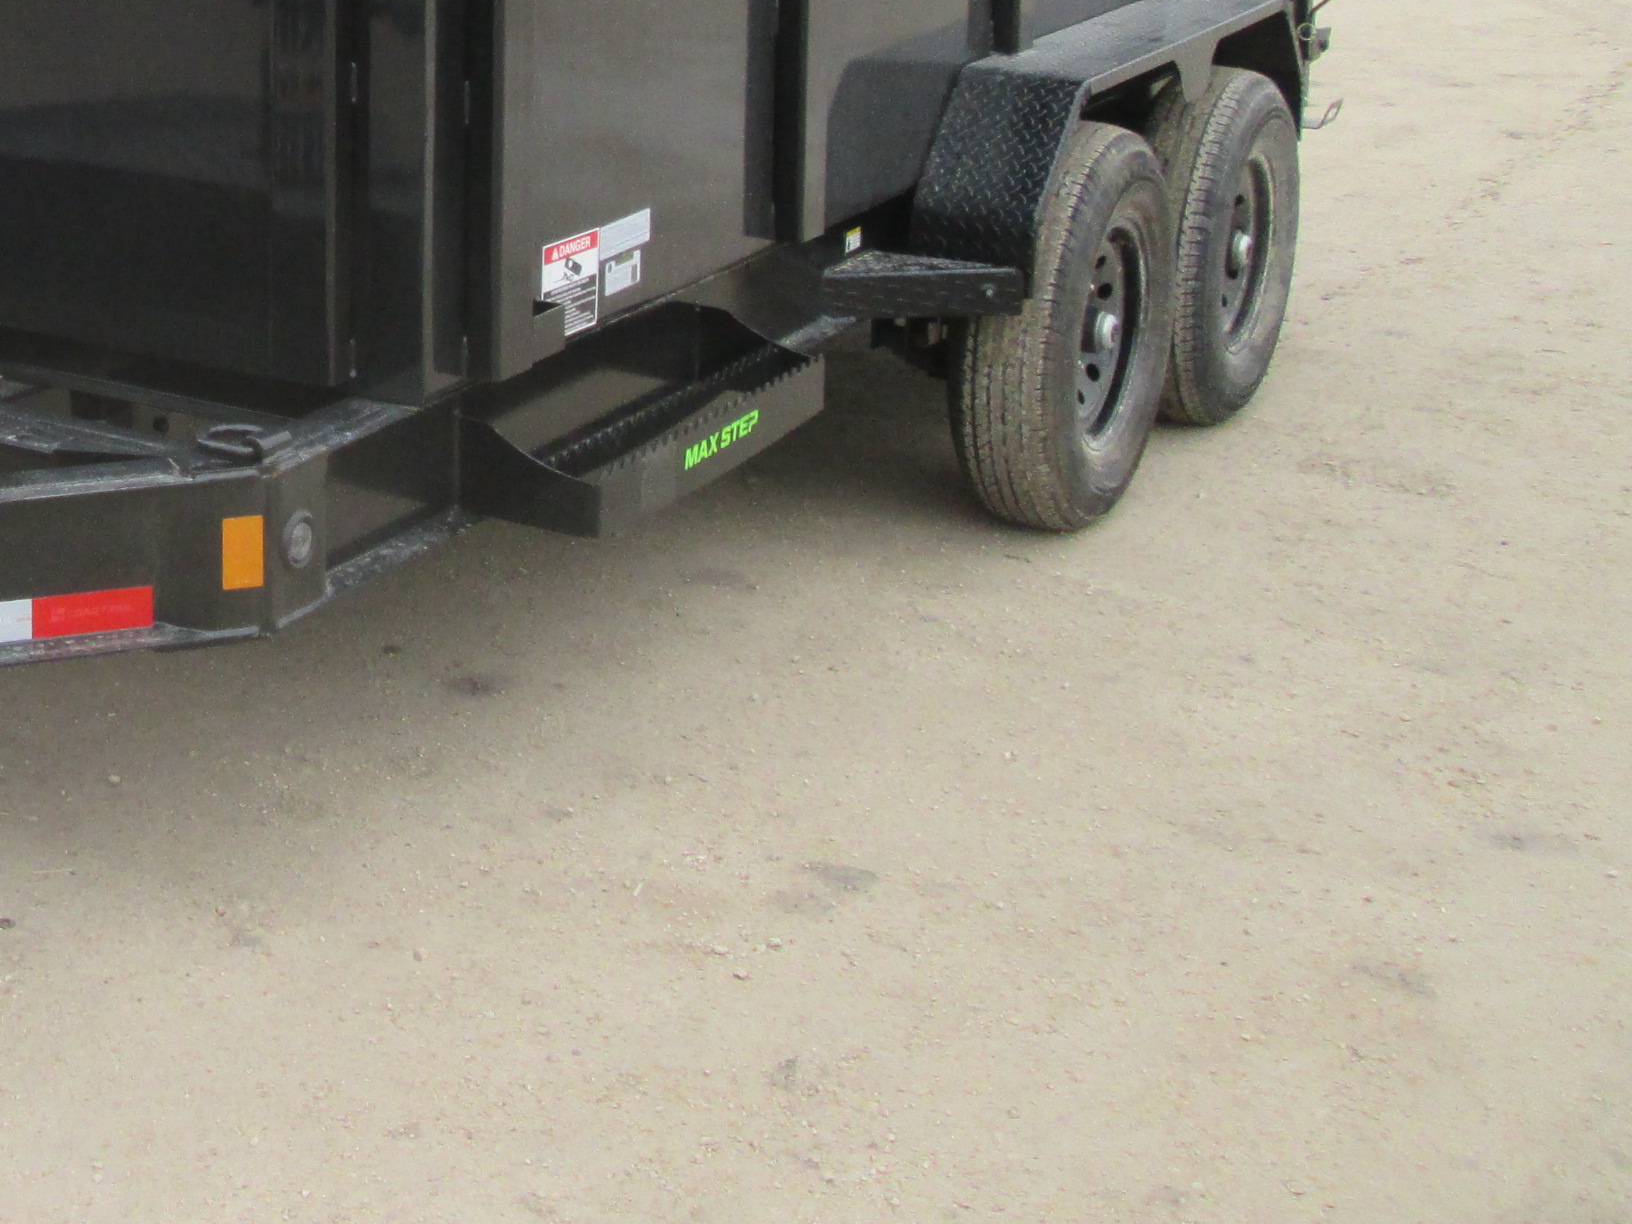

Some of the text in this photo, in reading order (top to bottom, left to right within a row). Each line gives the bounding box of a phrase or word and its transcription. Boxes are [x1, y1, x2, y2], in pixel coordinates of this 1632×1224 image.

[558, 236, 591, 258] DANGER
[684, 409, 760, 470] MAX STEP
